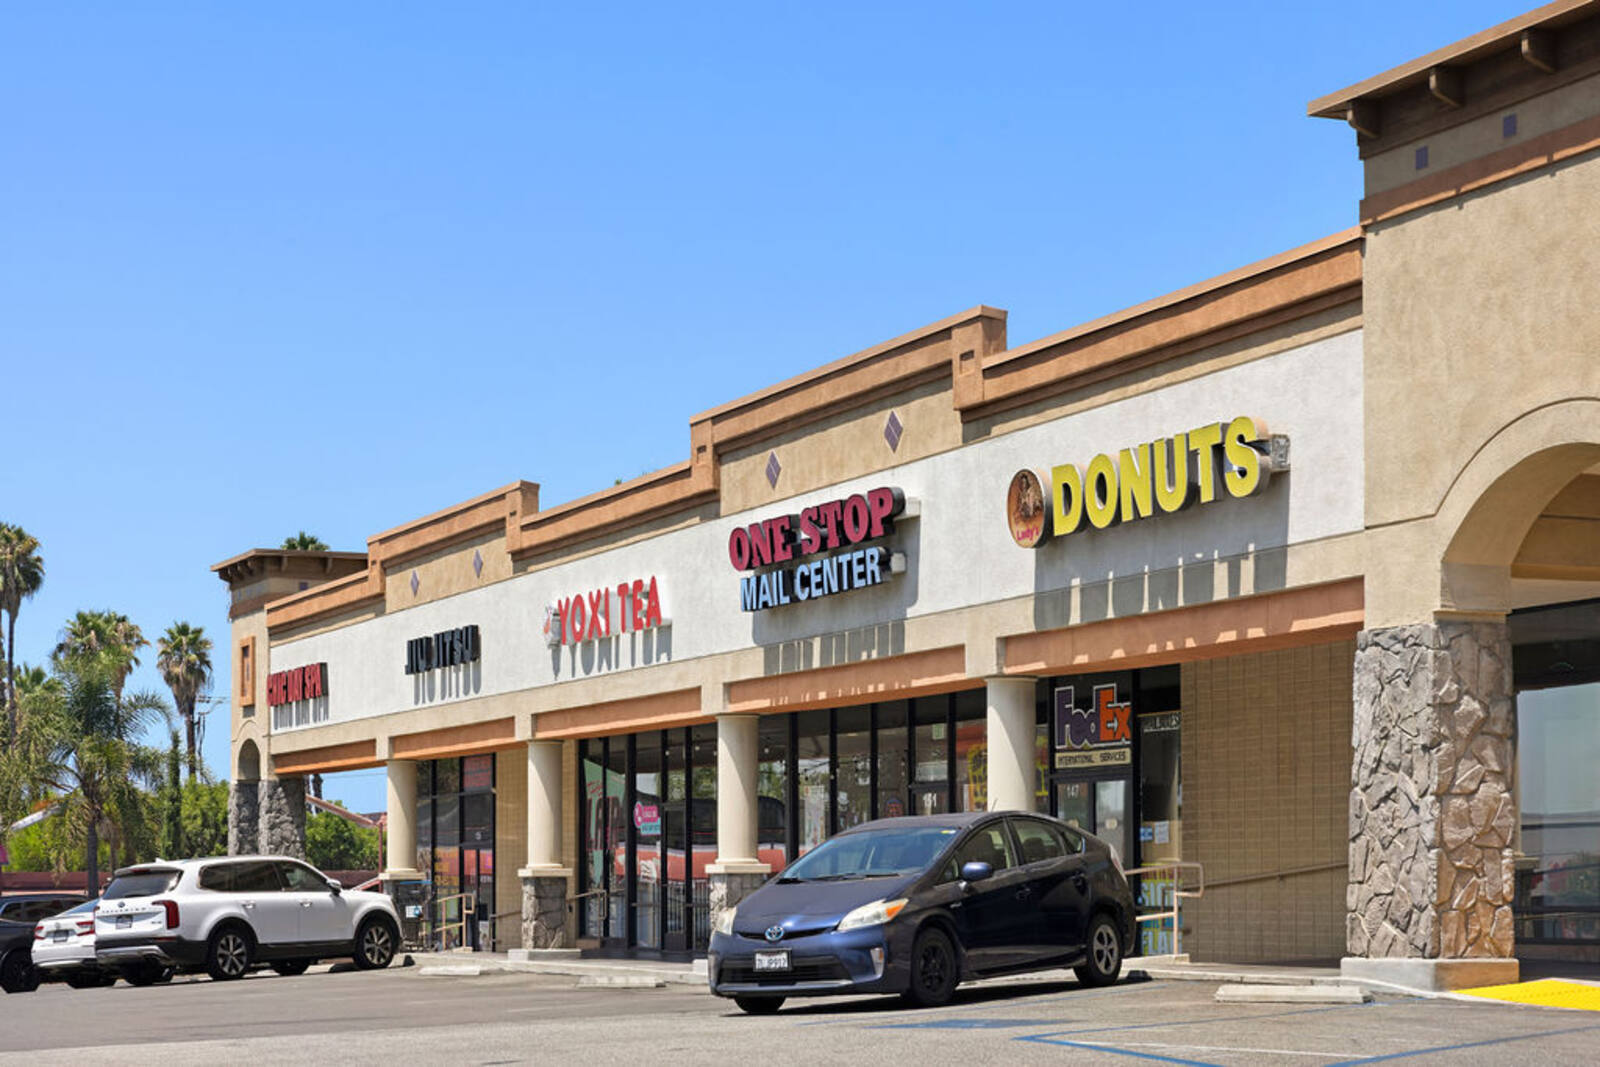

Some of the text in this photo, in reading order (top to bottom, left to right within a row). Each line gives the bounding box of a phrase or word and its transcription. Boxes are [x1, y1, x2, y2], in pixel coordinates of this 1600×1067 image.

[1051, 416, 1261, 537] DONUTS
[729, 487, 894, 571] ONE STOP
[557, 575, 662, 646] YOXI TEA
[740, 547, 882, 612] MAIL CENTER
[405, 625, 474, 675] JIU JITSU
[1055, 683, 1131, 749] FedEx
